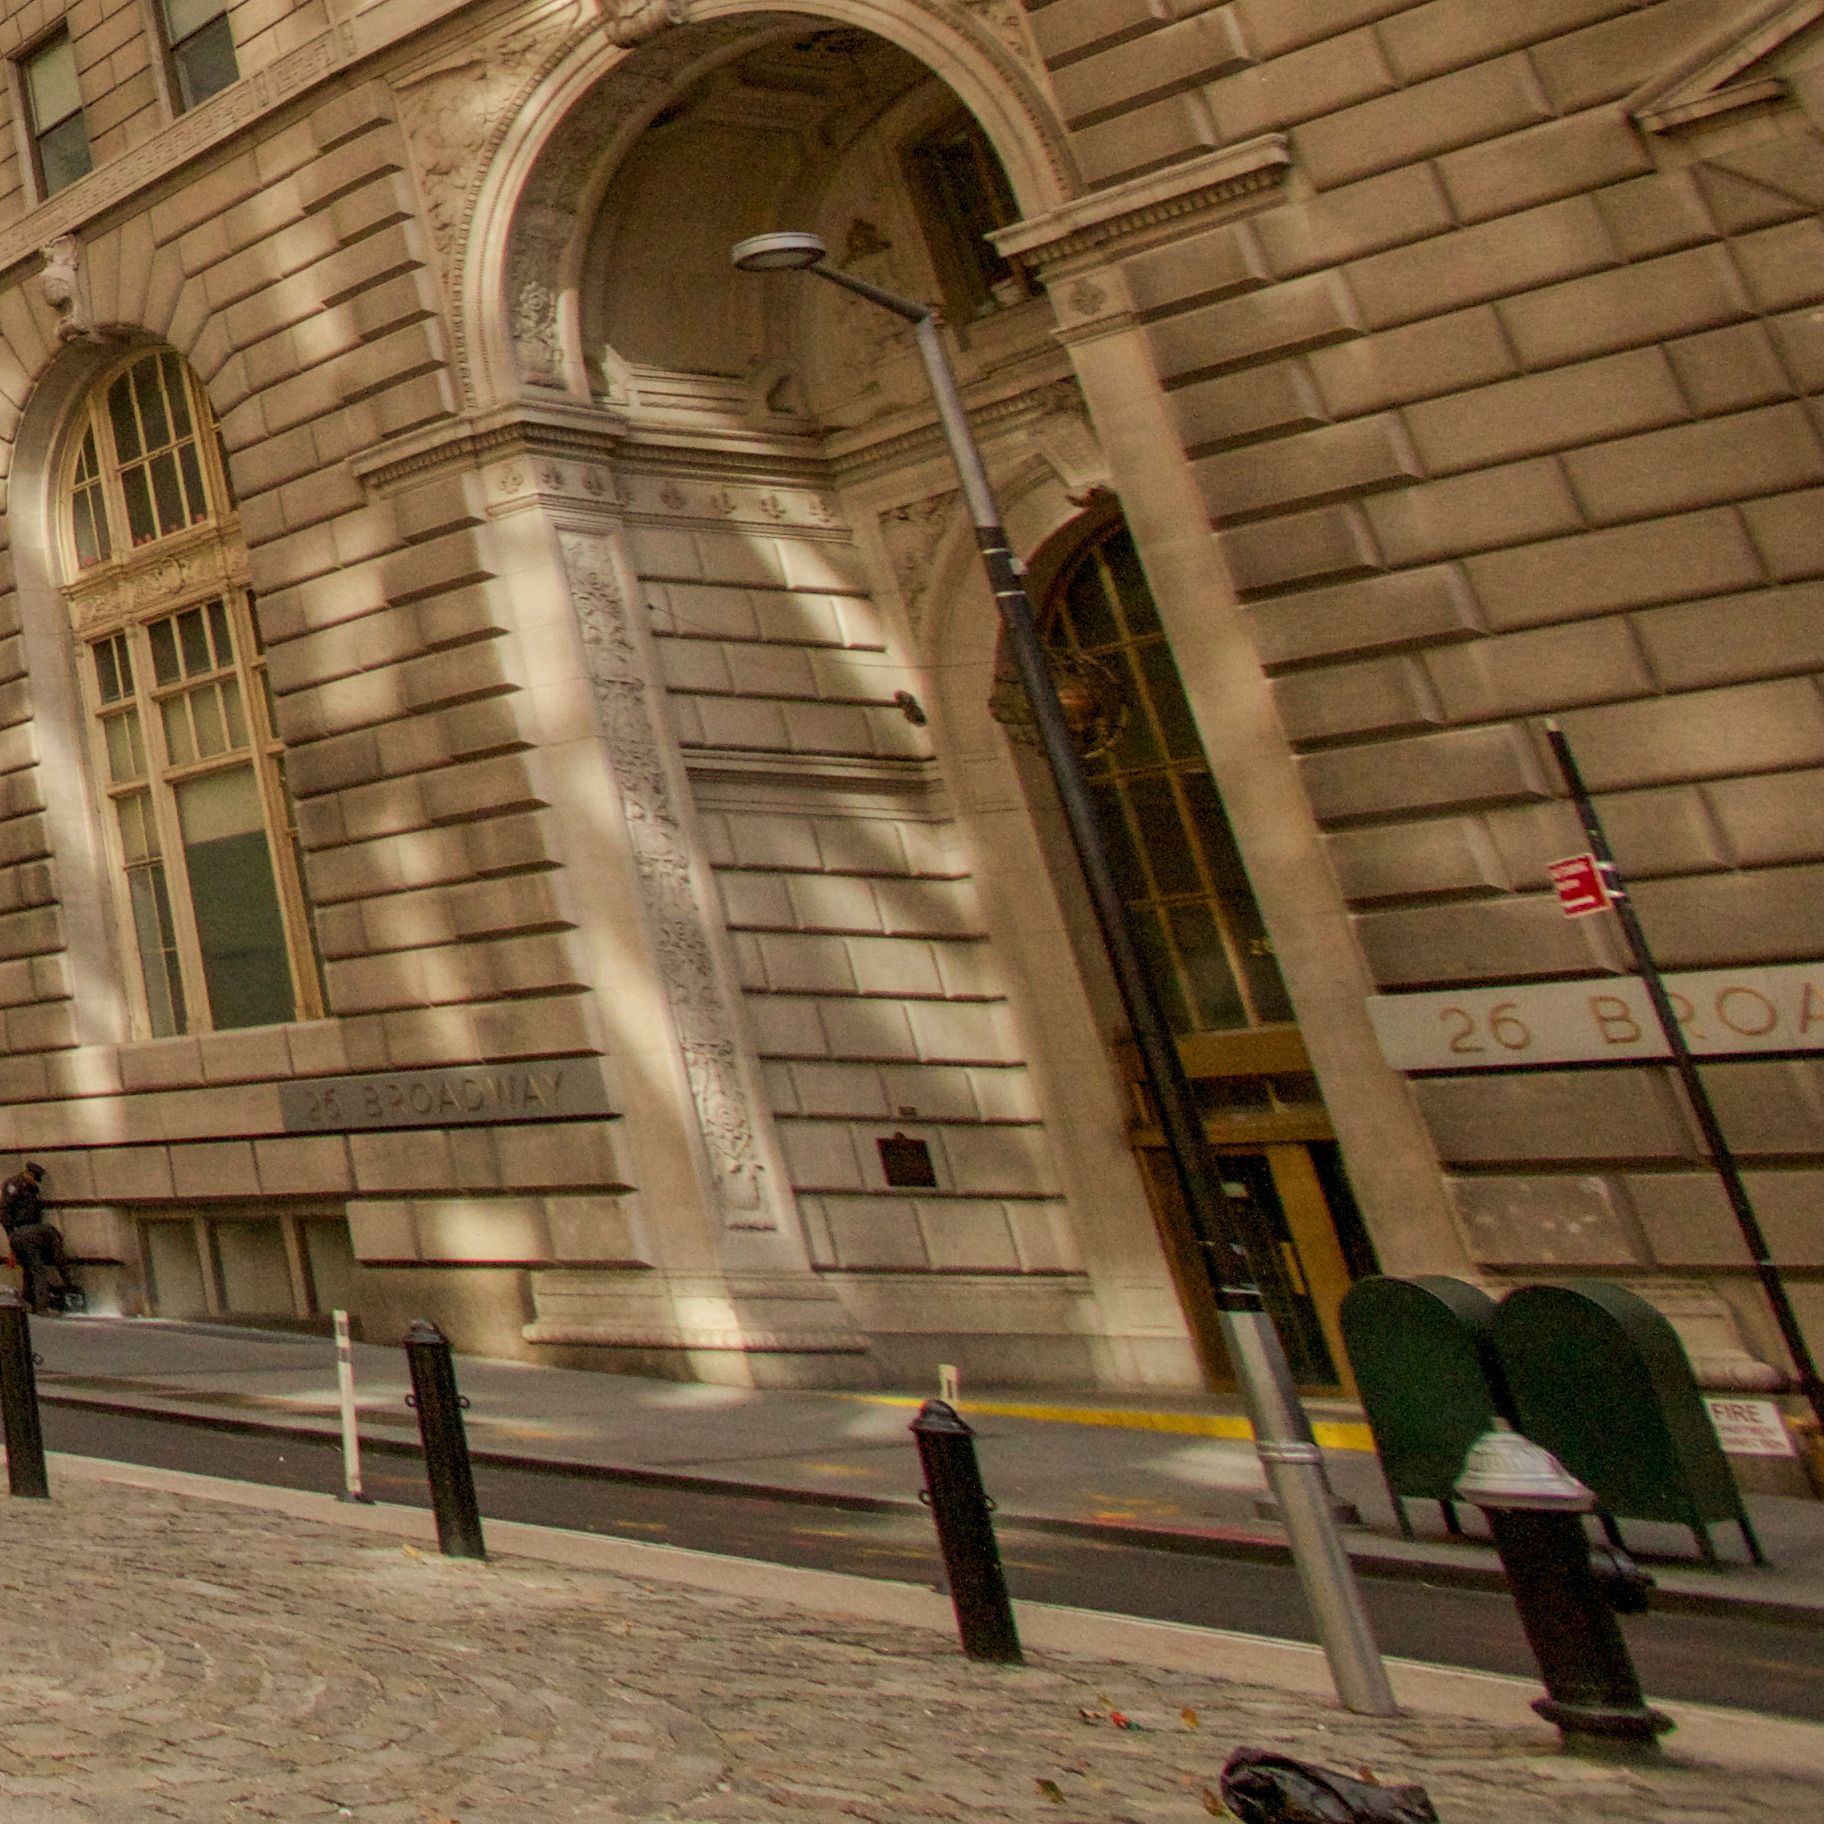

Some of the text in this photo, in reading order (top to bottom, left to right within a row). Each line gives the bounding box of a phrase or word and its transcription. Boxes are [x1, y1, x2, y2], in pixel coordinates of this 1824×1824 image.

[1439, 1002, 1533, 1054] 26
[363, 1071, 564, 1119] BROADWAY
[1710, 1402, 1763, 1423] FIRE
